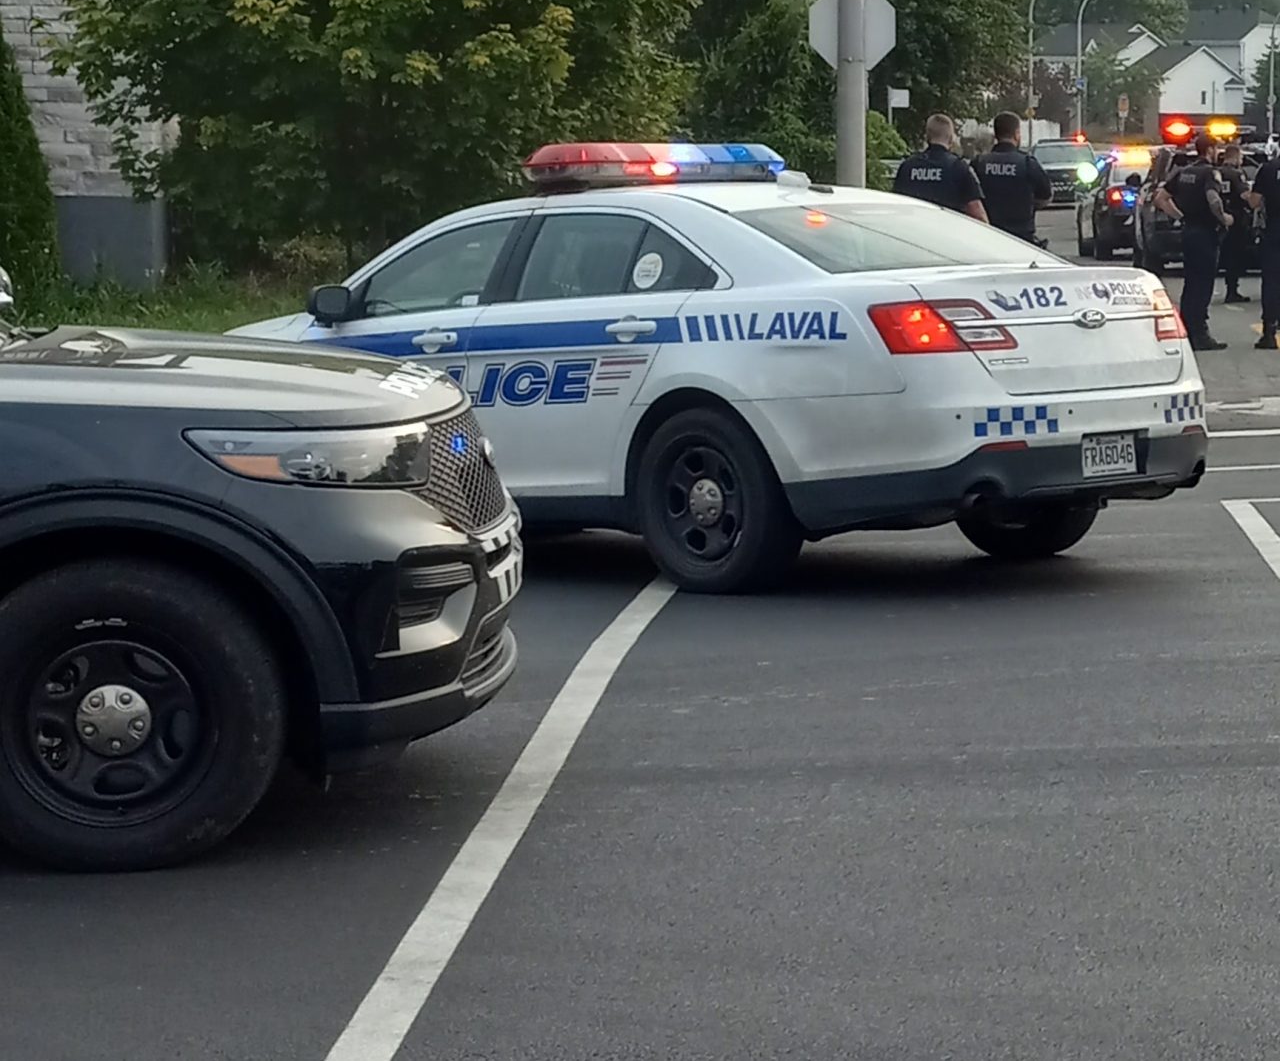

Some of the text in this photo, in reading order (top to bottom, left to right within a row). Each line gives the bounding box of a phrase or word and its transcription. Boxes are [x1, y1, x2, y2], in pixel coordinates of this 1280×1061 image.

[911, 168, 943, 181] POLICE
[985, 163, 1017, 176] POLICE
[1020, 286, 1068, 310] 182
[1109, 282, 1147, 296] POLICE
[748, 311, 848, 341] LAVAL
[1084, 443, 1134, 468] FRA6046
